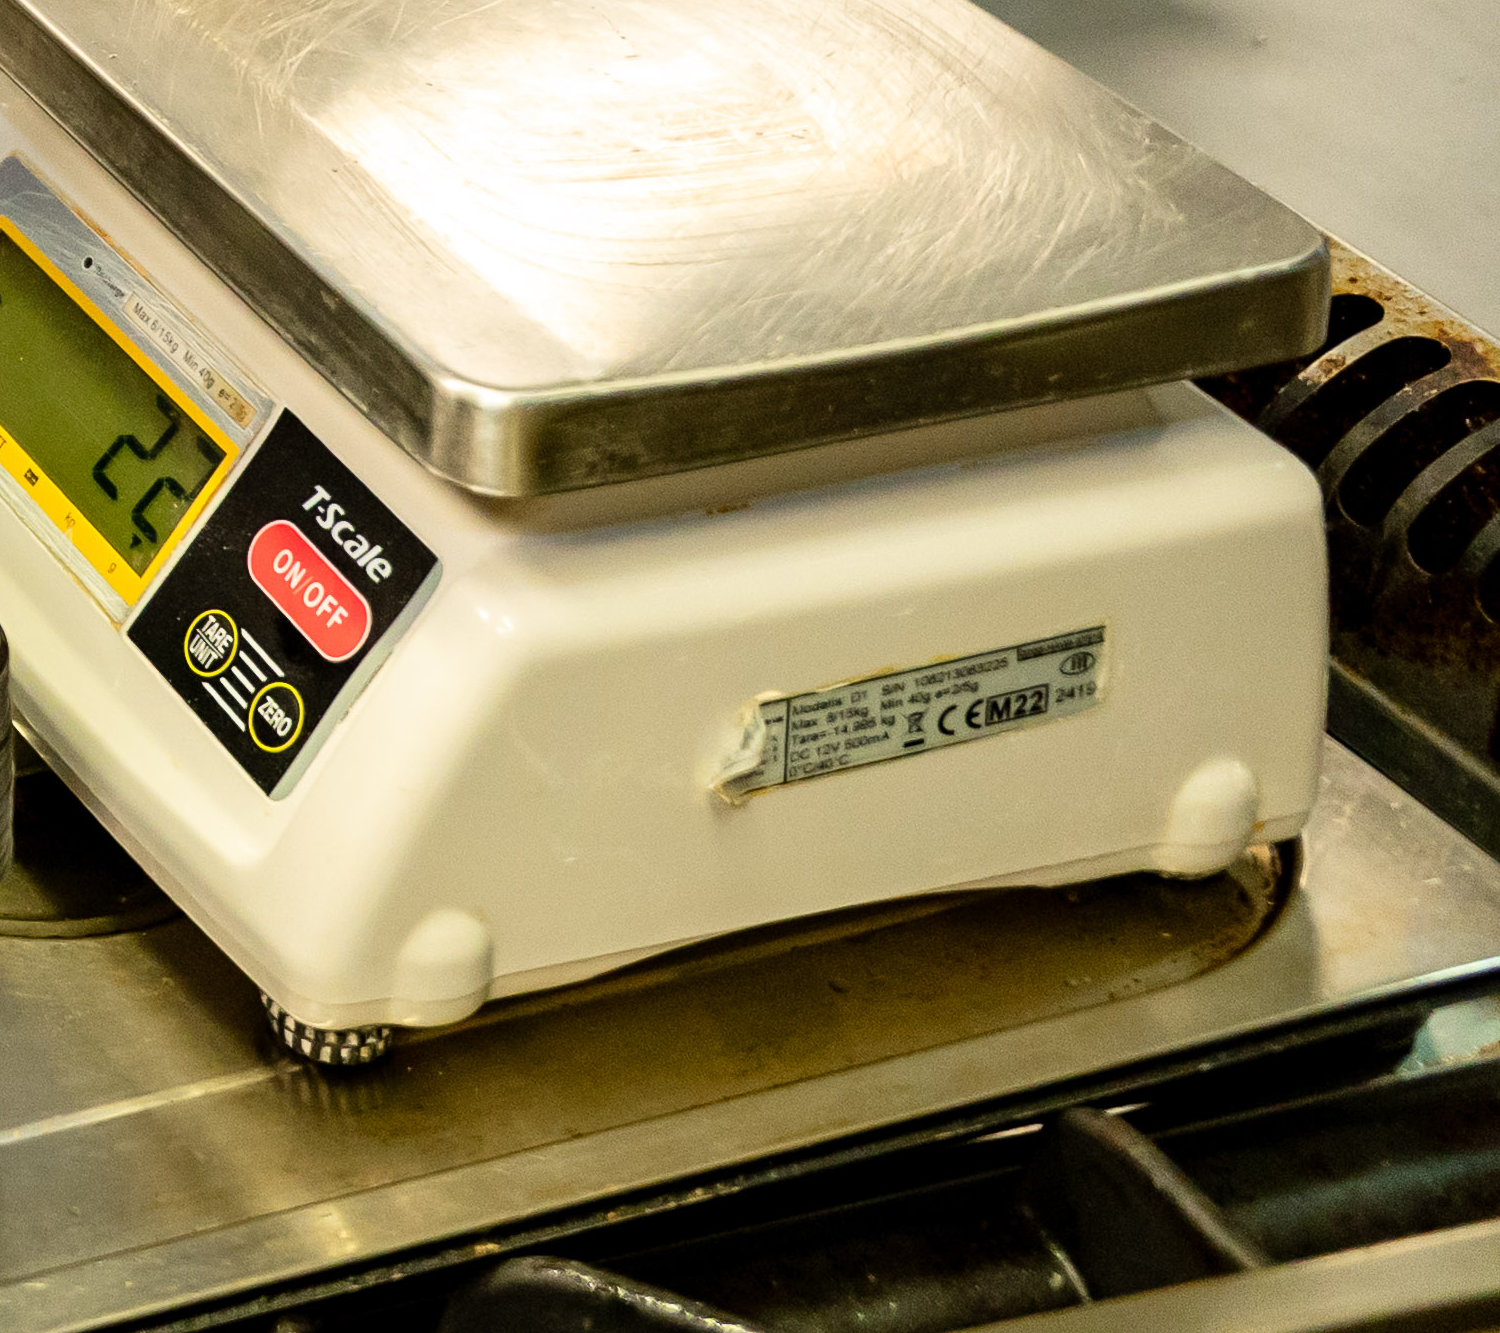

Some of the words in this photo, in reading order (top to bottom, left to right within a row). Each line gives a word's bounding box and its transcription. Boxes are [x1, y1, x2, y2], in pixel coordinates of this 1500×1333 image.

[133, 302, 150, 324] Max
[150, 320, 179, 353] 6/15kg
[183, 350, 199, 371] Min
[199, 367, 216, 389] 40g
[301, 485, 392, 584] T-Scale
[272, 549, 349, 628] ON/OFF
[189, 638, 218, 669] UNIT
[201, 615, 234, 653] TARE
[257, 695, 292, 737] ZERO
[990, 690, 1043, 721] M22
